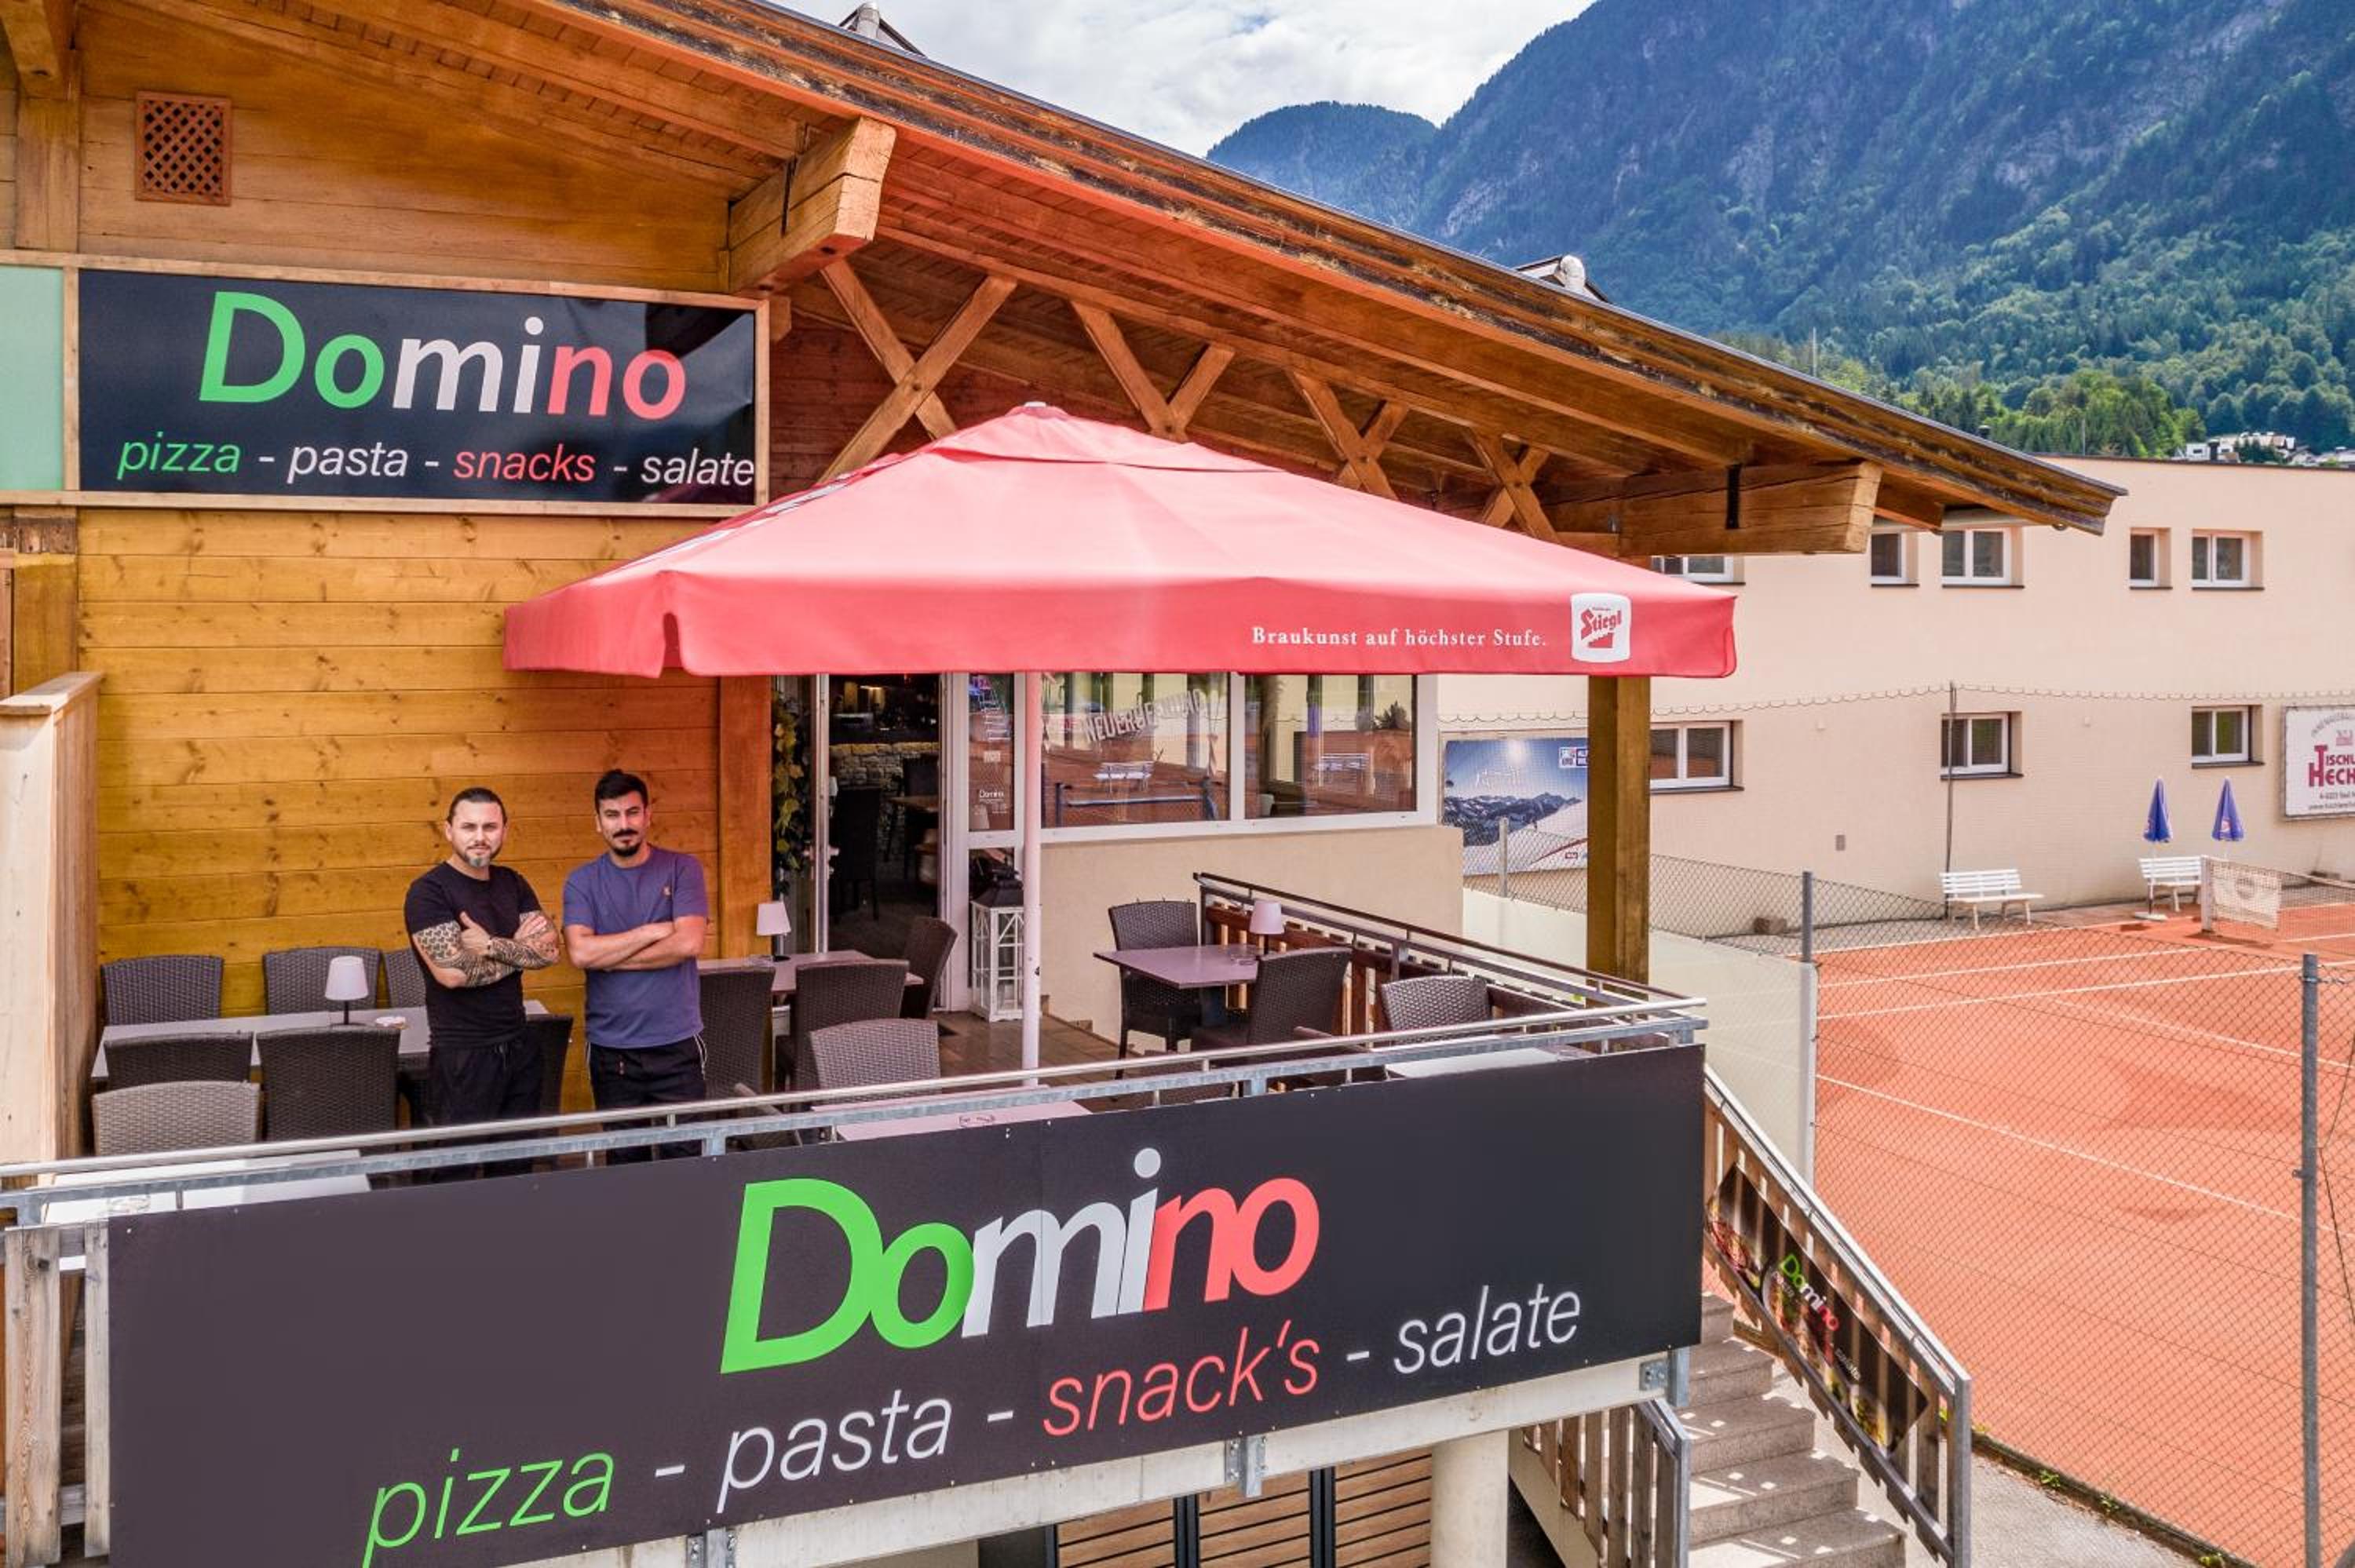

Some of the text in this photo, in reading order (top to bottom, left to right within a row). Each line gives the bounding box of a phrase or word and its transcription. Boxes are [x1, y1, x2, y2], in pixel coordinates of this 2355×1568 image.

[199, 291, 687, 420] Domino
[117, 432, 239, 480] pizza
[287, 441, 408, 484] pasta
[453, 444, 596, 482] snacks
[641, 448, 754, 487] salate
[1252, 626, 1546, 647] Braukunst auf höchster Stufe.
[1579, 608, 1623, 640] Stiegl
[720, 1147, 1320, 1374] Domino
[1780, 1254, 1839, 1331] Domino
[363, 1447, 614, 1568] pizza
[716, 1389, 952, 1514] pasta
[1042, 1318, 1320, 1437] snack's
[1393, 1283, 1581, 1374] salate
